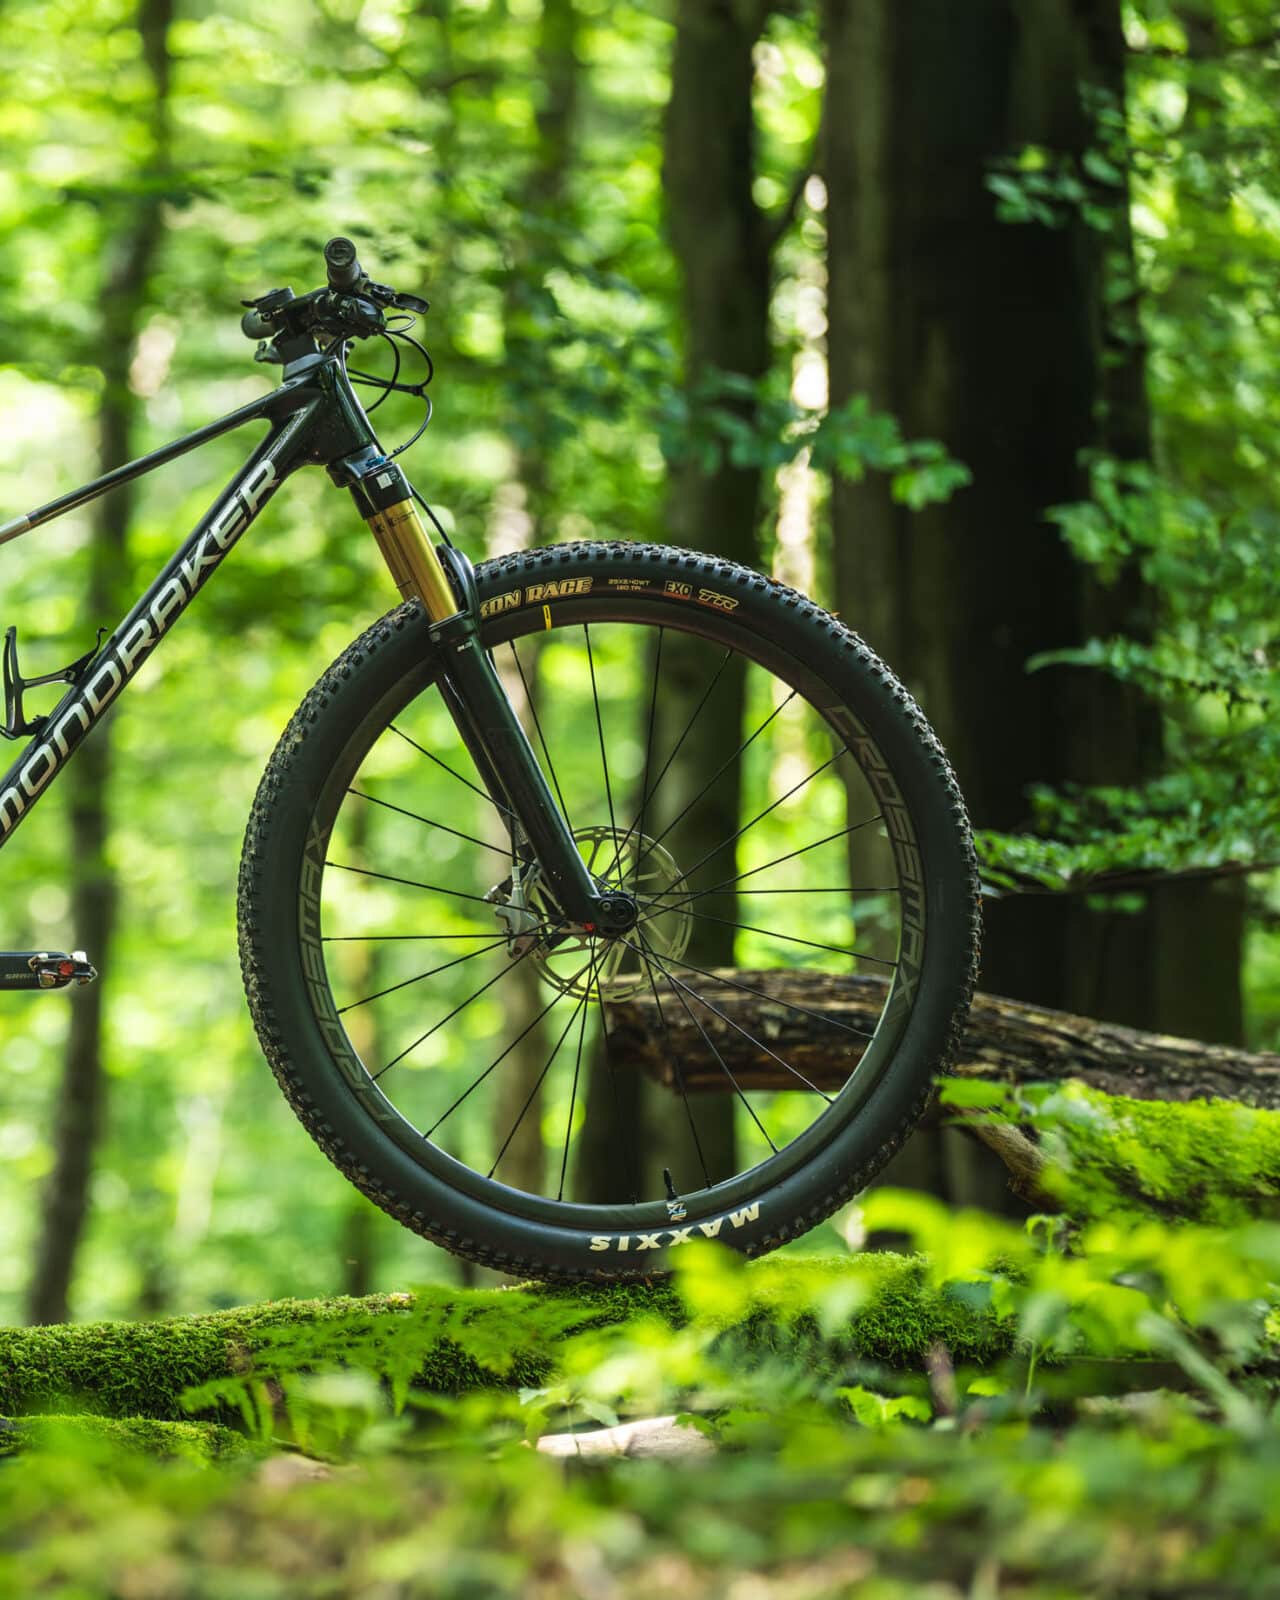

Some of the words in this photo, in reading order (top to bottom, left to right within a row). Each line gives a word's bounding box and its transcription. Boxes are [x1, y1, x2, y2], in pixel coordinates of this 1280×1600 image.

[526, 576, 593, 604] RACE
[666, 580, 692, 595] EXO
[698, 588, 740, 611] TR
[589, 1202, 760, 1251] MAXXIS
